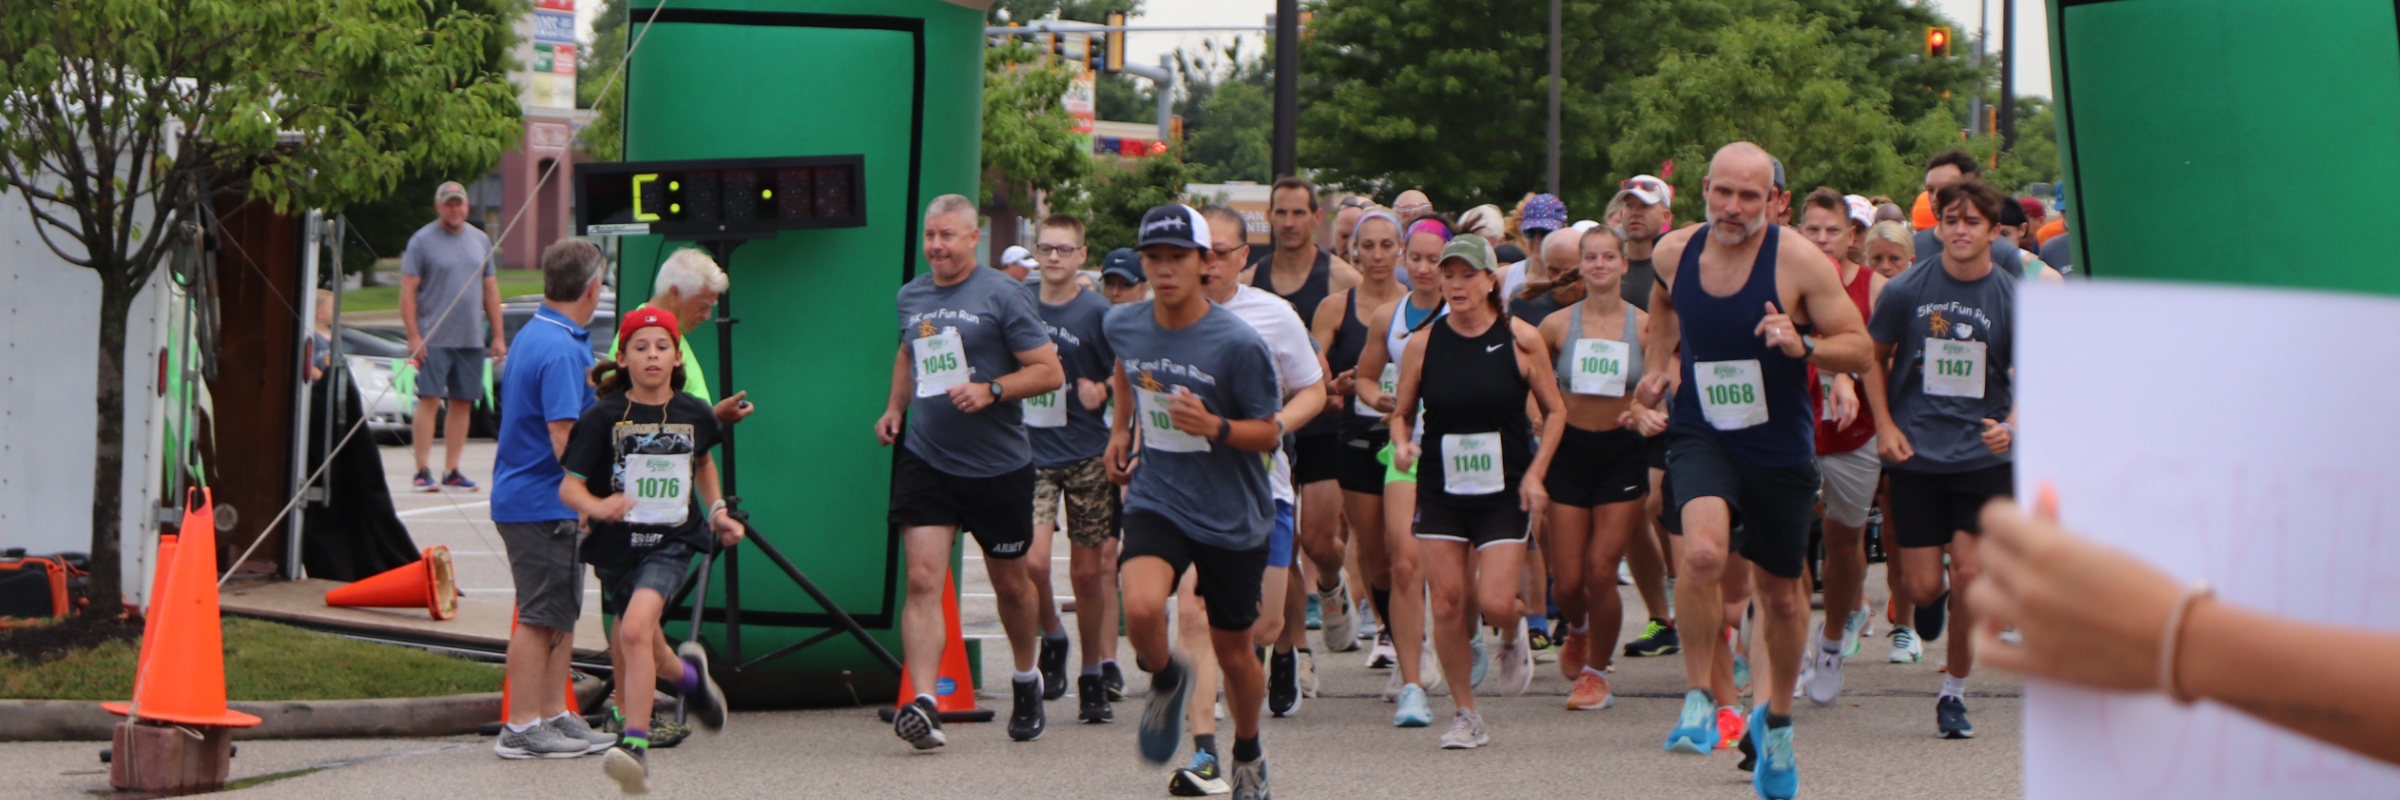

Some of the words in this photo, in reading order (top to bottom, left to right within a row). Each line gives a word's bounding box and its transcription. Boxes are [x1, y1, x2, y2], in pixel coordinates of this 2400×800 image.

[1246, 221, 1271, 233] NTE
[939, 308, 957, 319] Fun
[959, 309, 979, 324] Run
[1917, 304, 1934, 318] 5K
[1933, 302, 1949, 312] and
[1951, 301, 1973, 316] Fun
[1974, 308, 1992, 329] Run
[1059, 327, 1080, 346] Run
[923, 352, 958, 375] 1045
[1161, 358, 1186, 376] Fun
[1188, 364, 1216, 386] Run
[1581, 356, 1620, 376] 1004
[1936, 358, 1974, 376] 1147
[1705, 383, 1755, 405] 1068
[1453, 453, 1492, 473] 1140
[636, 477, 680, 498] 1076
[992, 540, 1025, 552] ARMY
